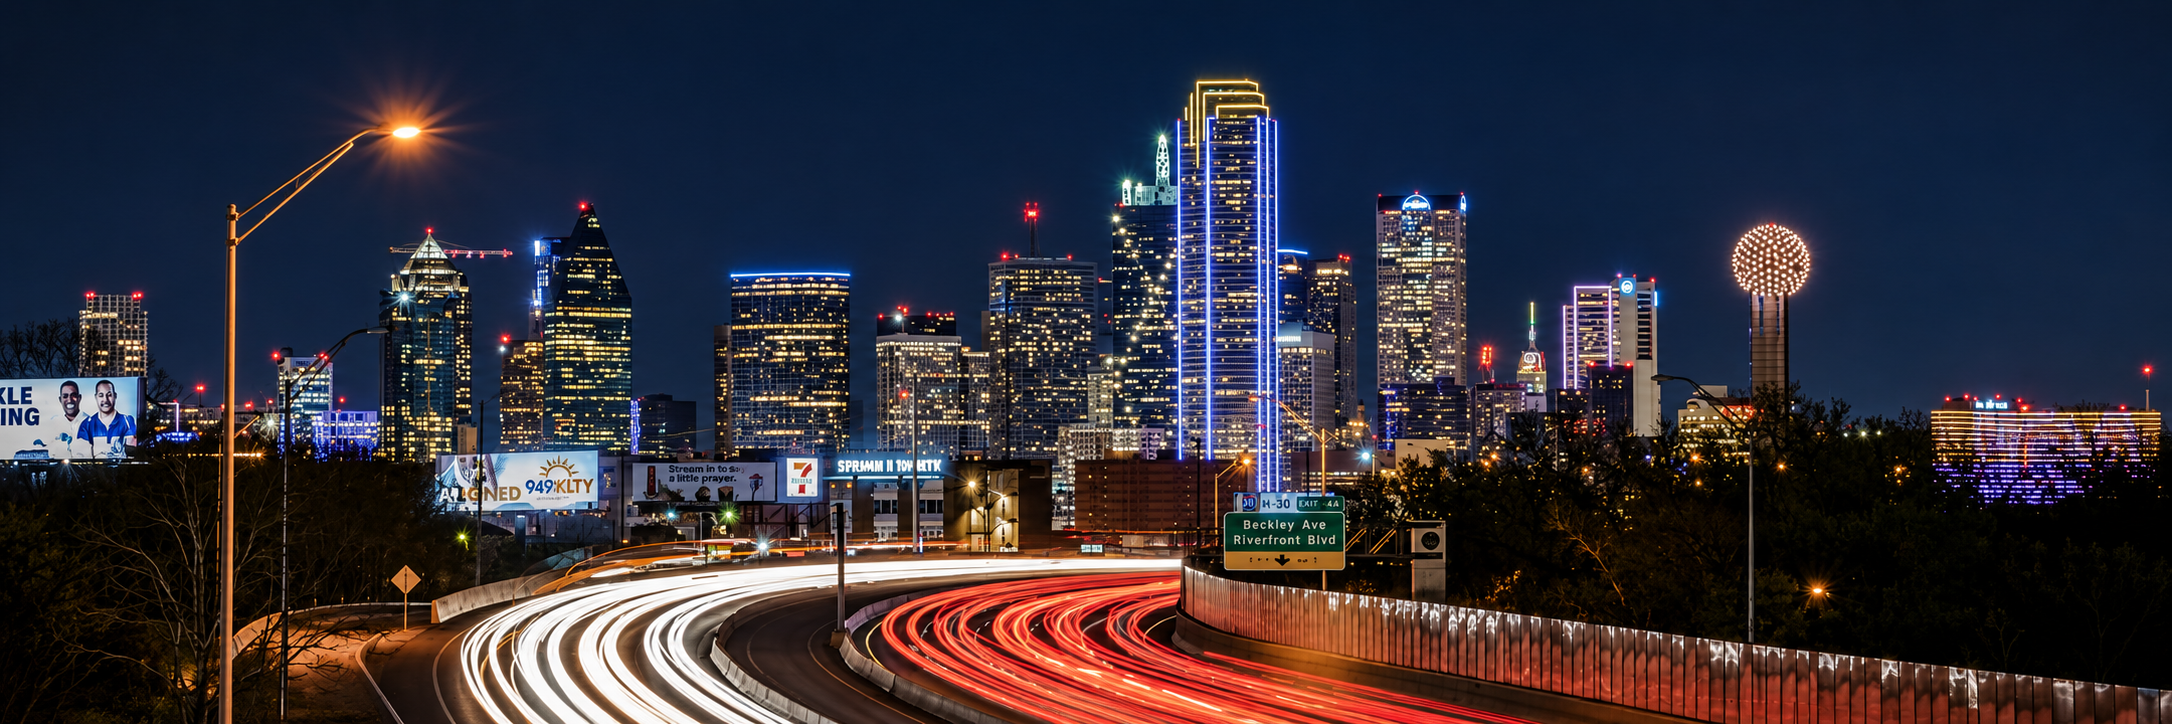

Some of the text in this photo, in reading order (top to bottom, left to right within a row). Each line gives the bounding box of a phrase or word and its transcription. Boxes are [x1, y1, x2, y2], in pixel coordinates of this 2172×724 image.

[1, 407, 40, 426] ING
[668, 464, 704, 473] Stream
[706, 464, 715, 473] in
[717, 465, 728, 473] to
[676, 473, 699, 483] little
[701, 475, 737, 485] prayer.
[556, 478, 594, 494] KLTY
[1298, 499, 1318, 508] EXIT
[1243, 519, 1327, 532] Beckley Ave
[1233, 534, 1336, 545] Riverfront Blvd
